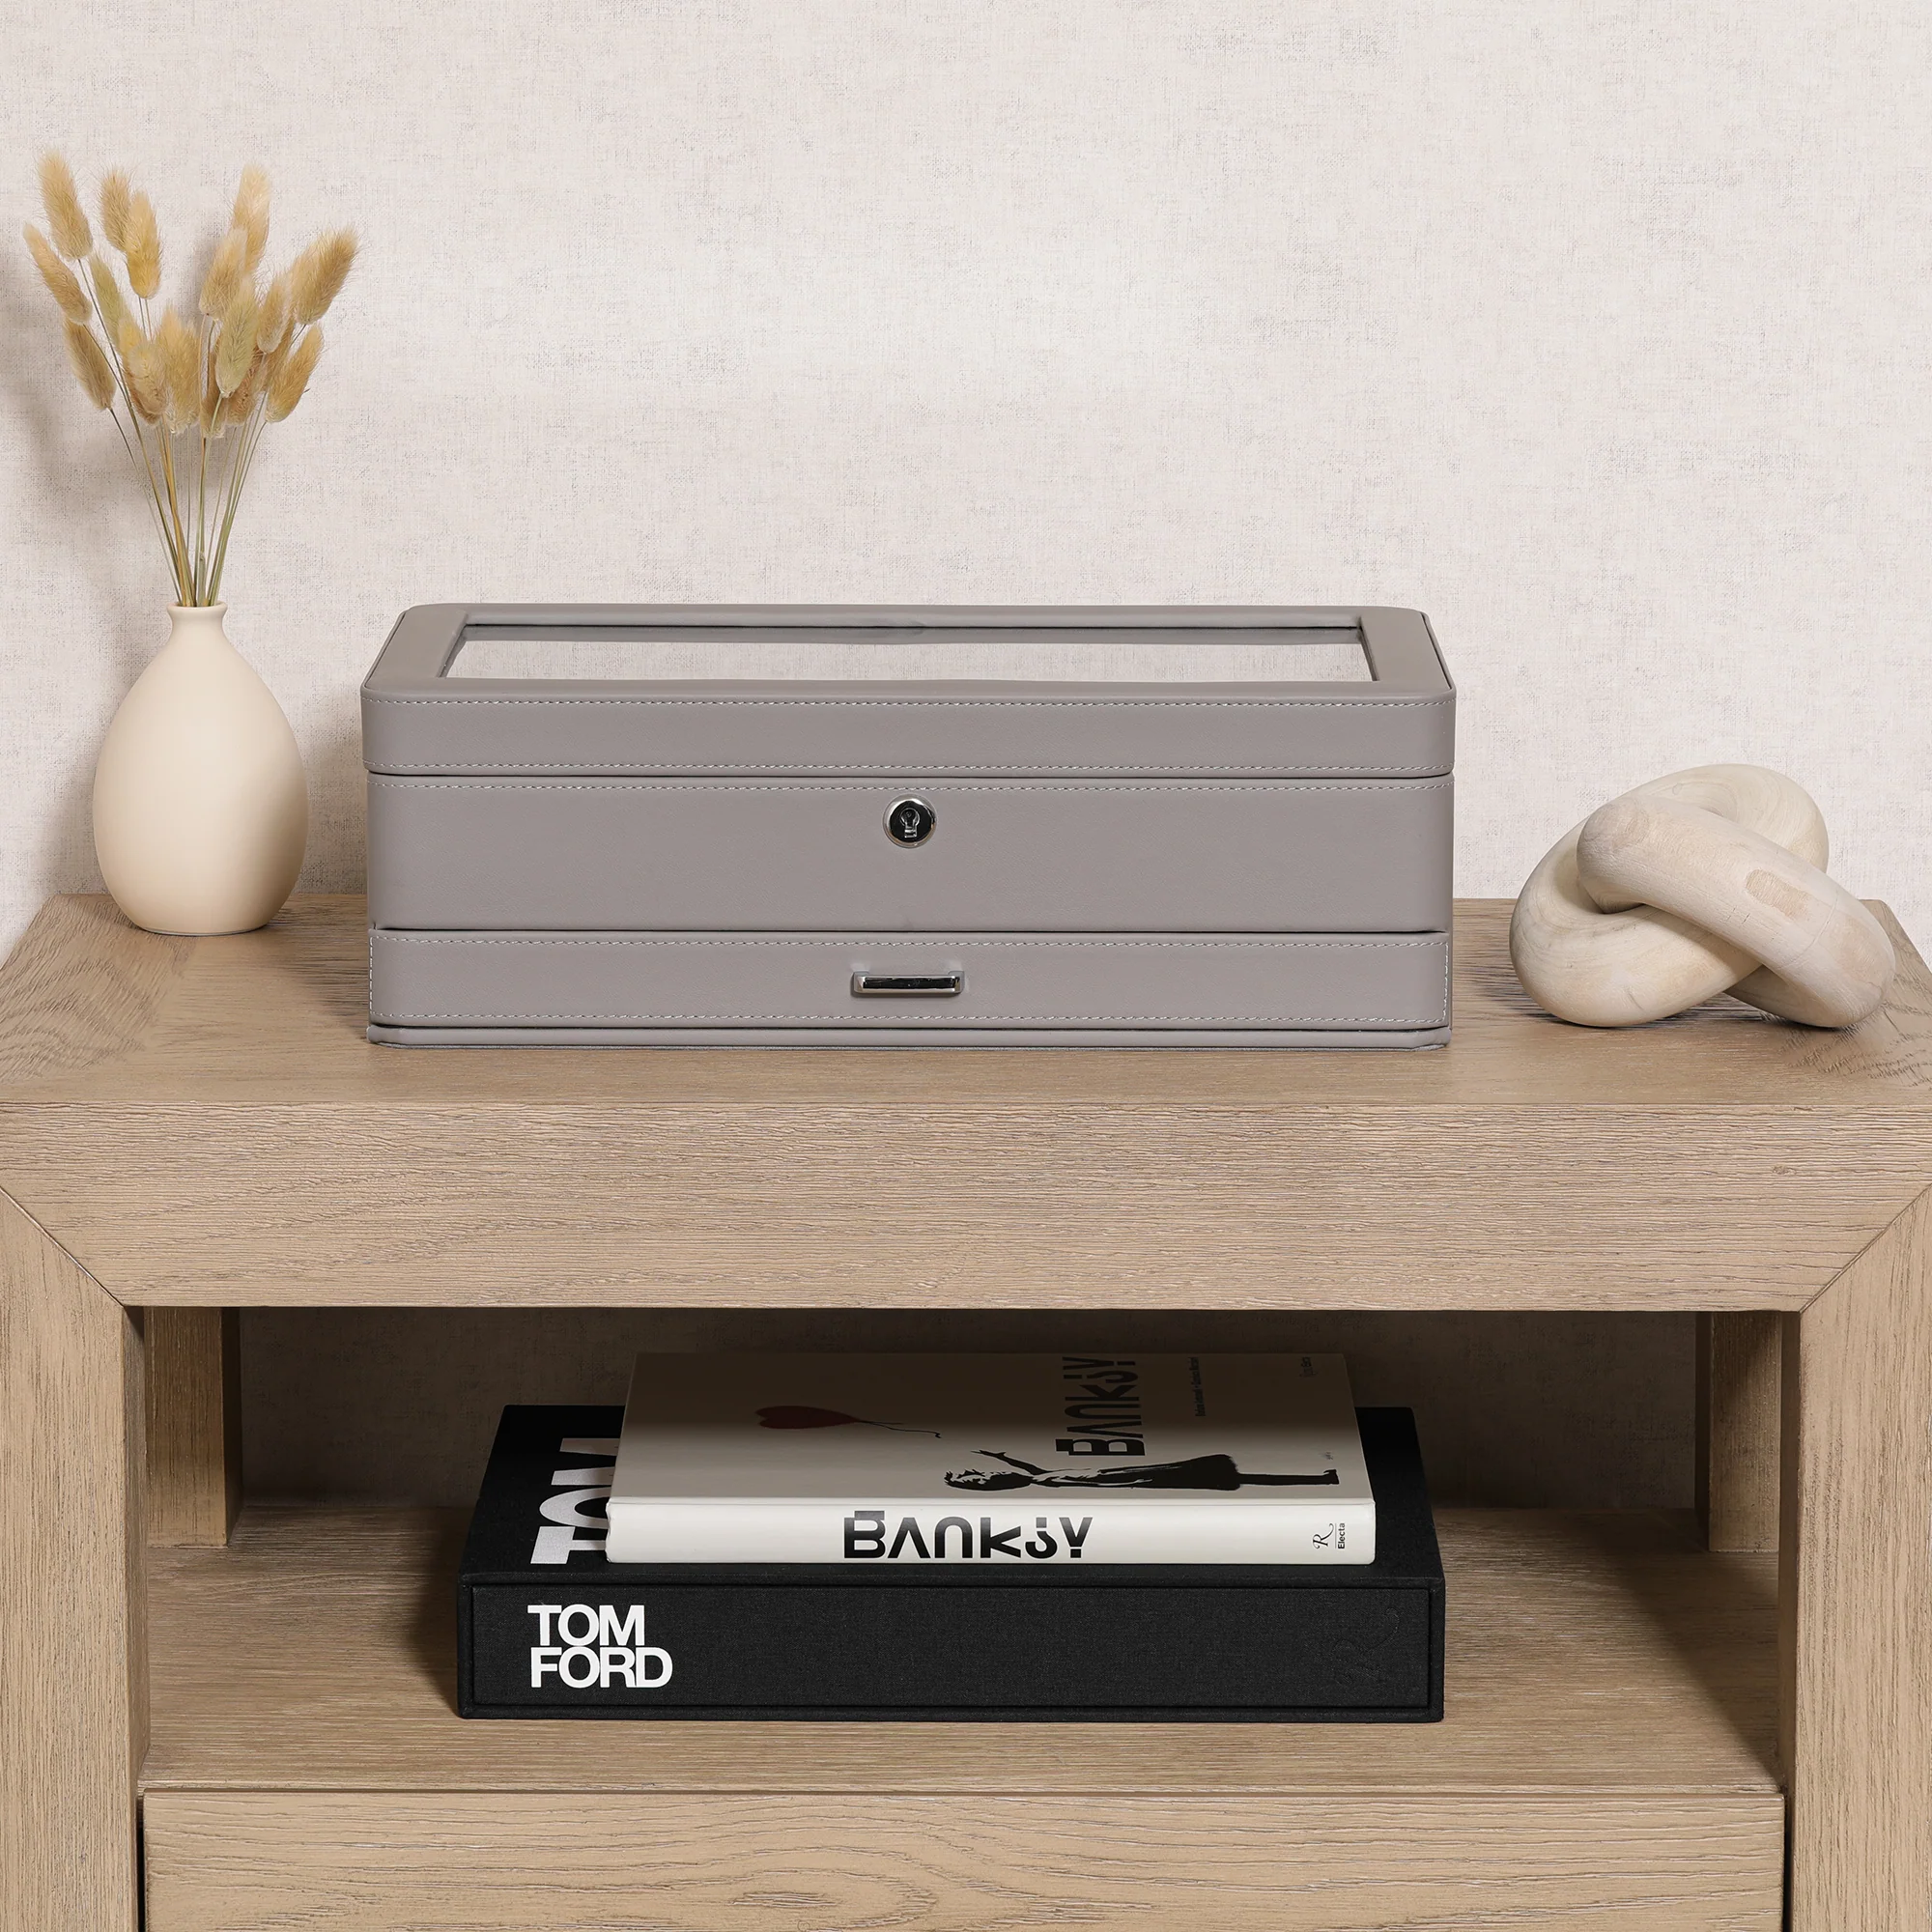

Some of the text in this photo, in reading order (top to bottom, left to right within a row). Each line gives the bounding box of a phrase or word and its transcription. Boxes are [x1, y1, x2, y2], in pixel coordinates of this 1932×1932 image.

[1055, 1356, 1146, 1456] BANKSY
[844, 1510, 1094, 1559] BANKSY
[1337, 1522, 1346, 1549] Electa
[527, 1604, 645, 1646] TOM
[530, 1645, 673, 1689] FORD
